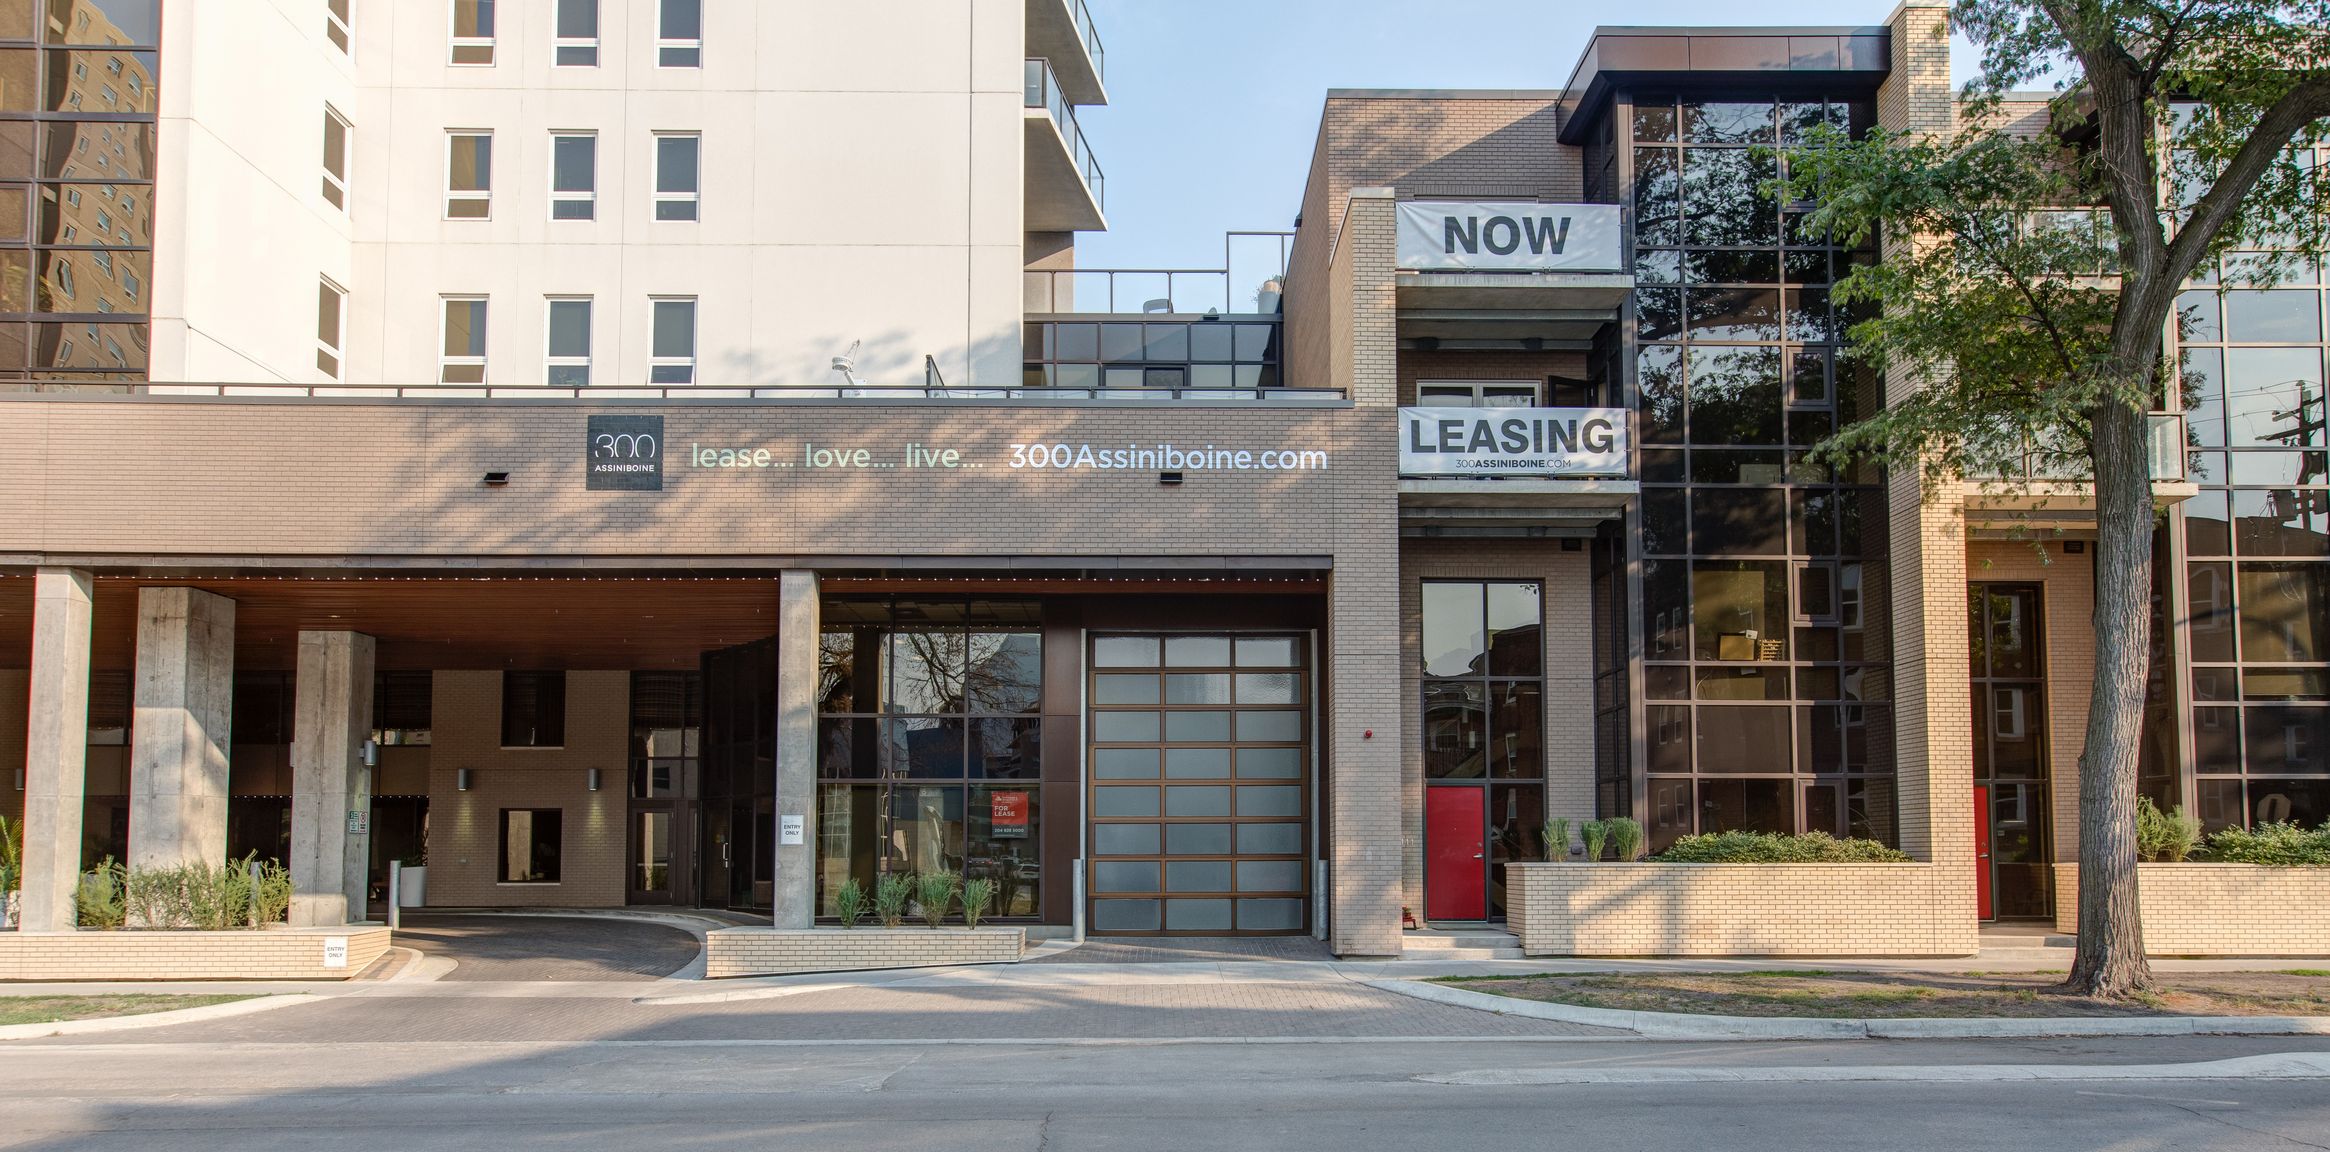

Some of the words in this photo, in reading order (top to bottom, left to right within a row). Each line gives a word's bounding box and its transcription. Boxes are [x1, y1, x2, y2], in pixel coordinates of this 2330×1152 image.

[1444, 216, 1571, 255] NOW
[595, 433, 656, 458] 300
[1410, 418, 1614, 453] LEASING
[594, 464, 655, 472] ASSINIBOINE
[692, 442, 794, 468] lease...
[805, 443, 895, 468] love...
[906, 442, 983, 468] live...
[1008, 443, 1328, 470] 300Assiniboine.com
[1455, 459, 1572, 468] 300ASSINIBOINE.COM
